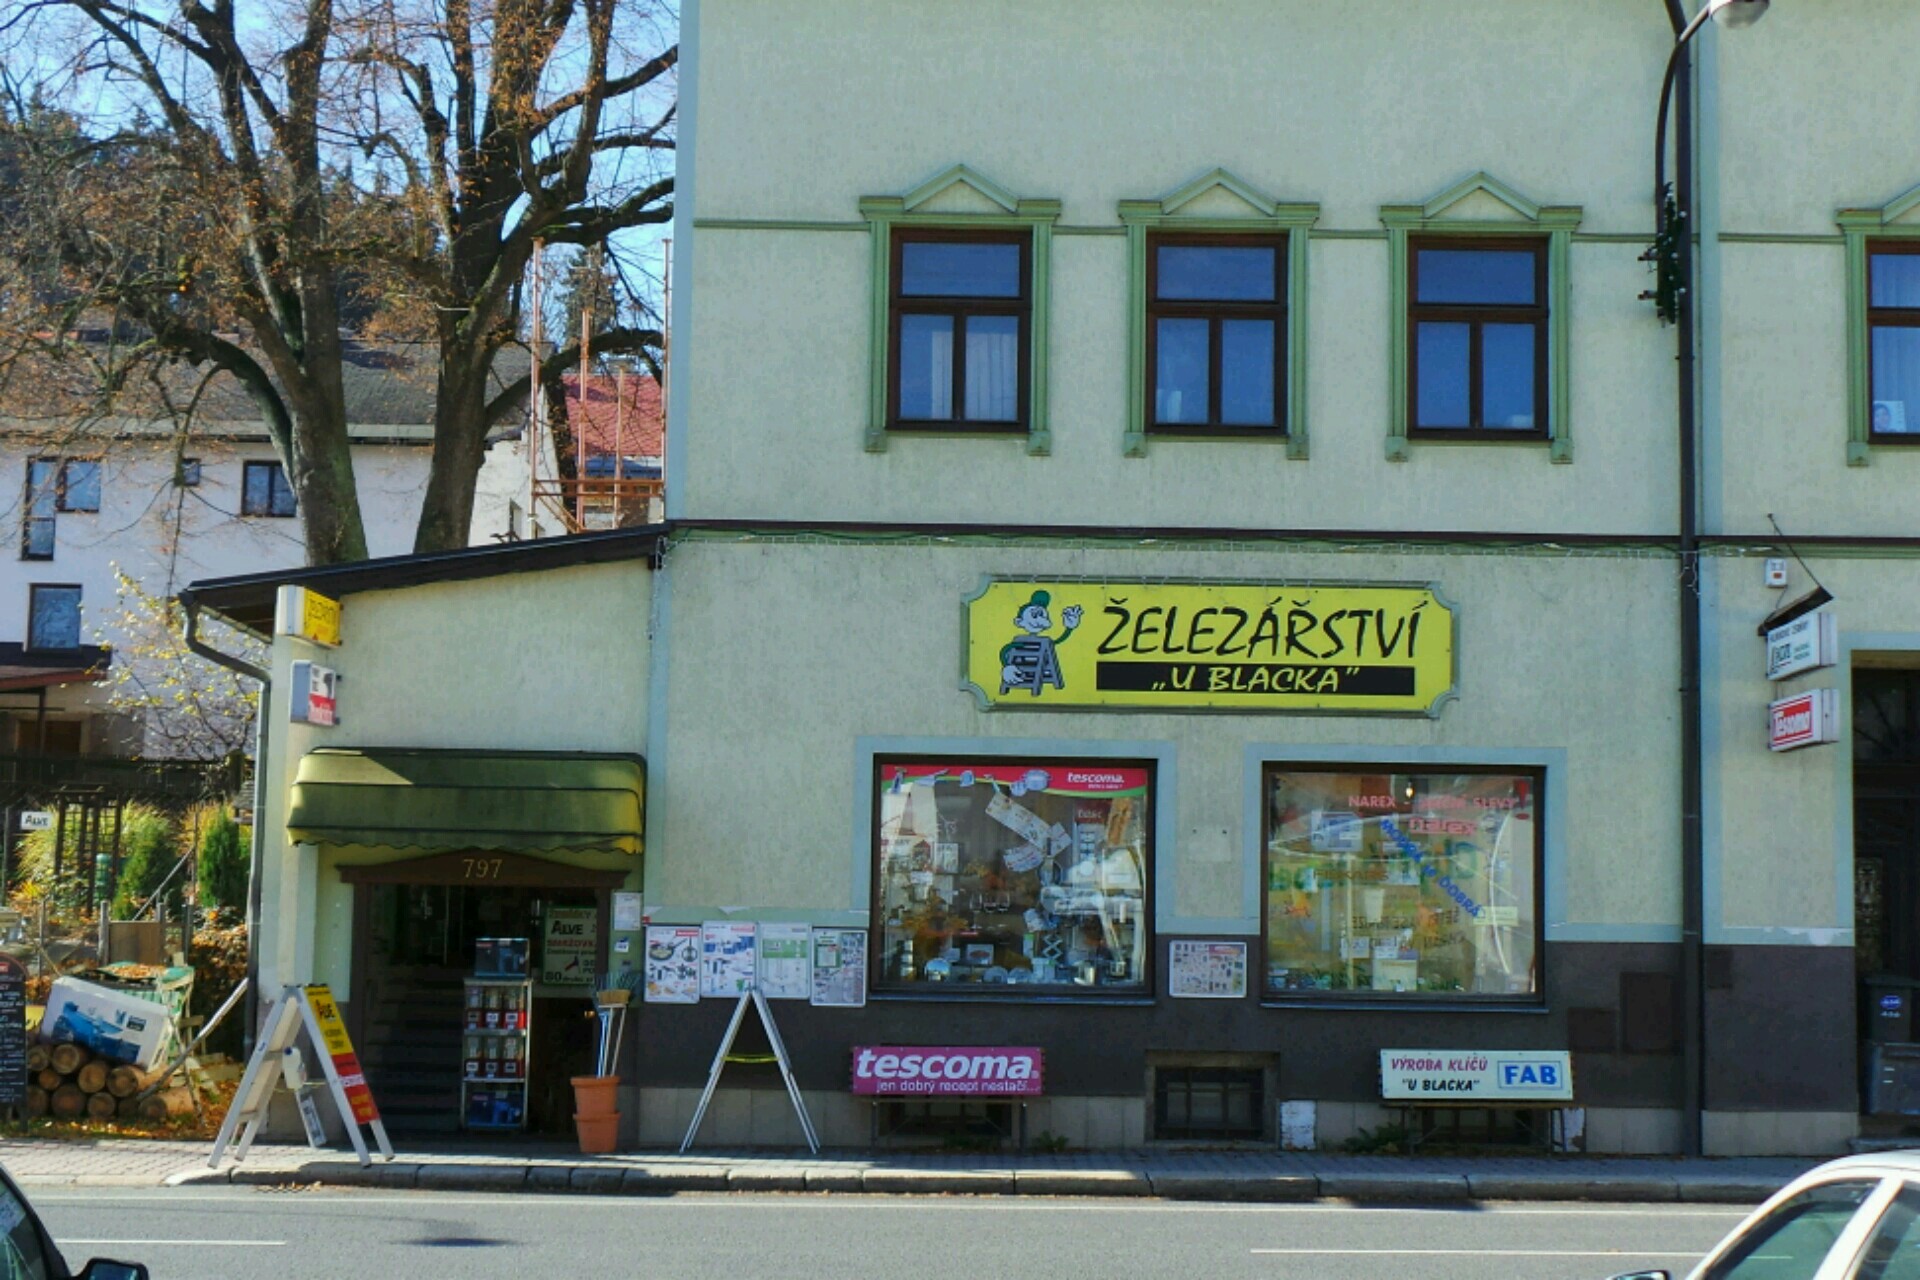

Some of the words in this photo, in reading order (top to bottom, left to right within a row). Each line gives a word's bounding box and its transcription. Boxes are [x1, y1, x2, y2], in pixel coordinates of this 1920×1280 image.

[1097, 598, 1430, 659] ŽELEZÁŘSTVÍ
[1068, 772, 1122, 783] tescoma
[1348, 794, 1397, 808] NAREX
[1408, 817, 1477, 835] narex
[462, 858, 503, 880] 797
[856, 1049, 1032, 1079] tescoma
[1391, 1055, 1443, 1072] VÝROBA
[1504, 1064, 1558, 1085] FAB
[900, 1080, 935, 1094] dobrý
